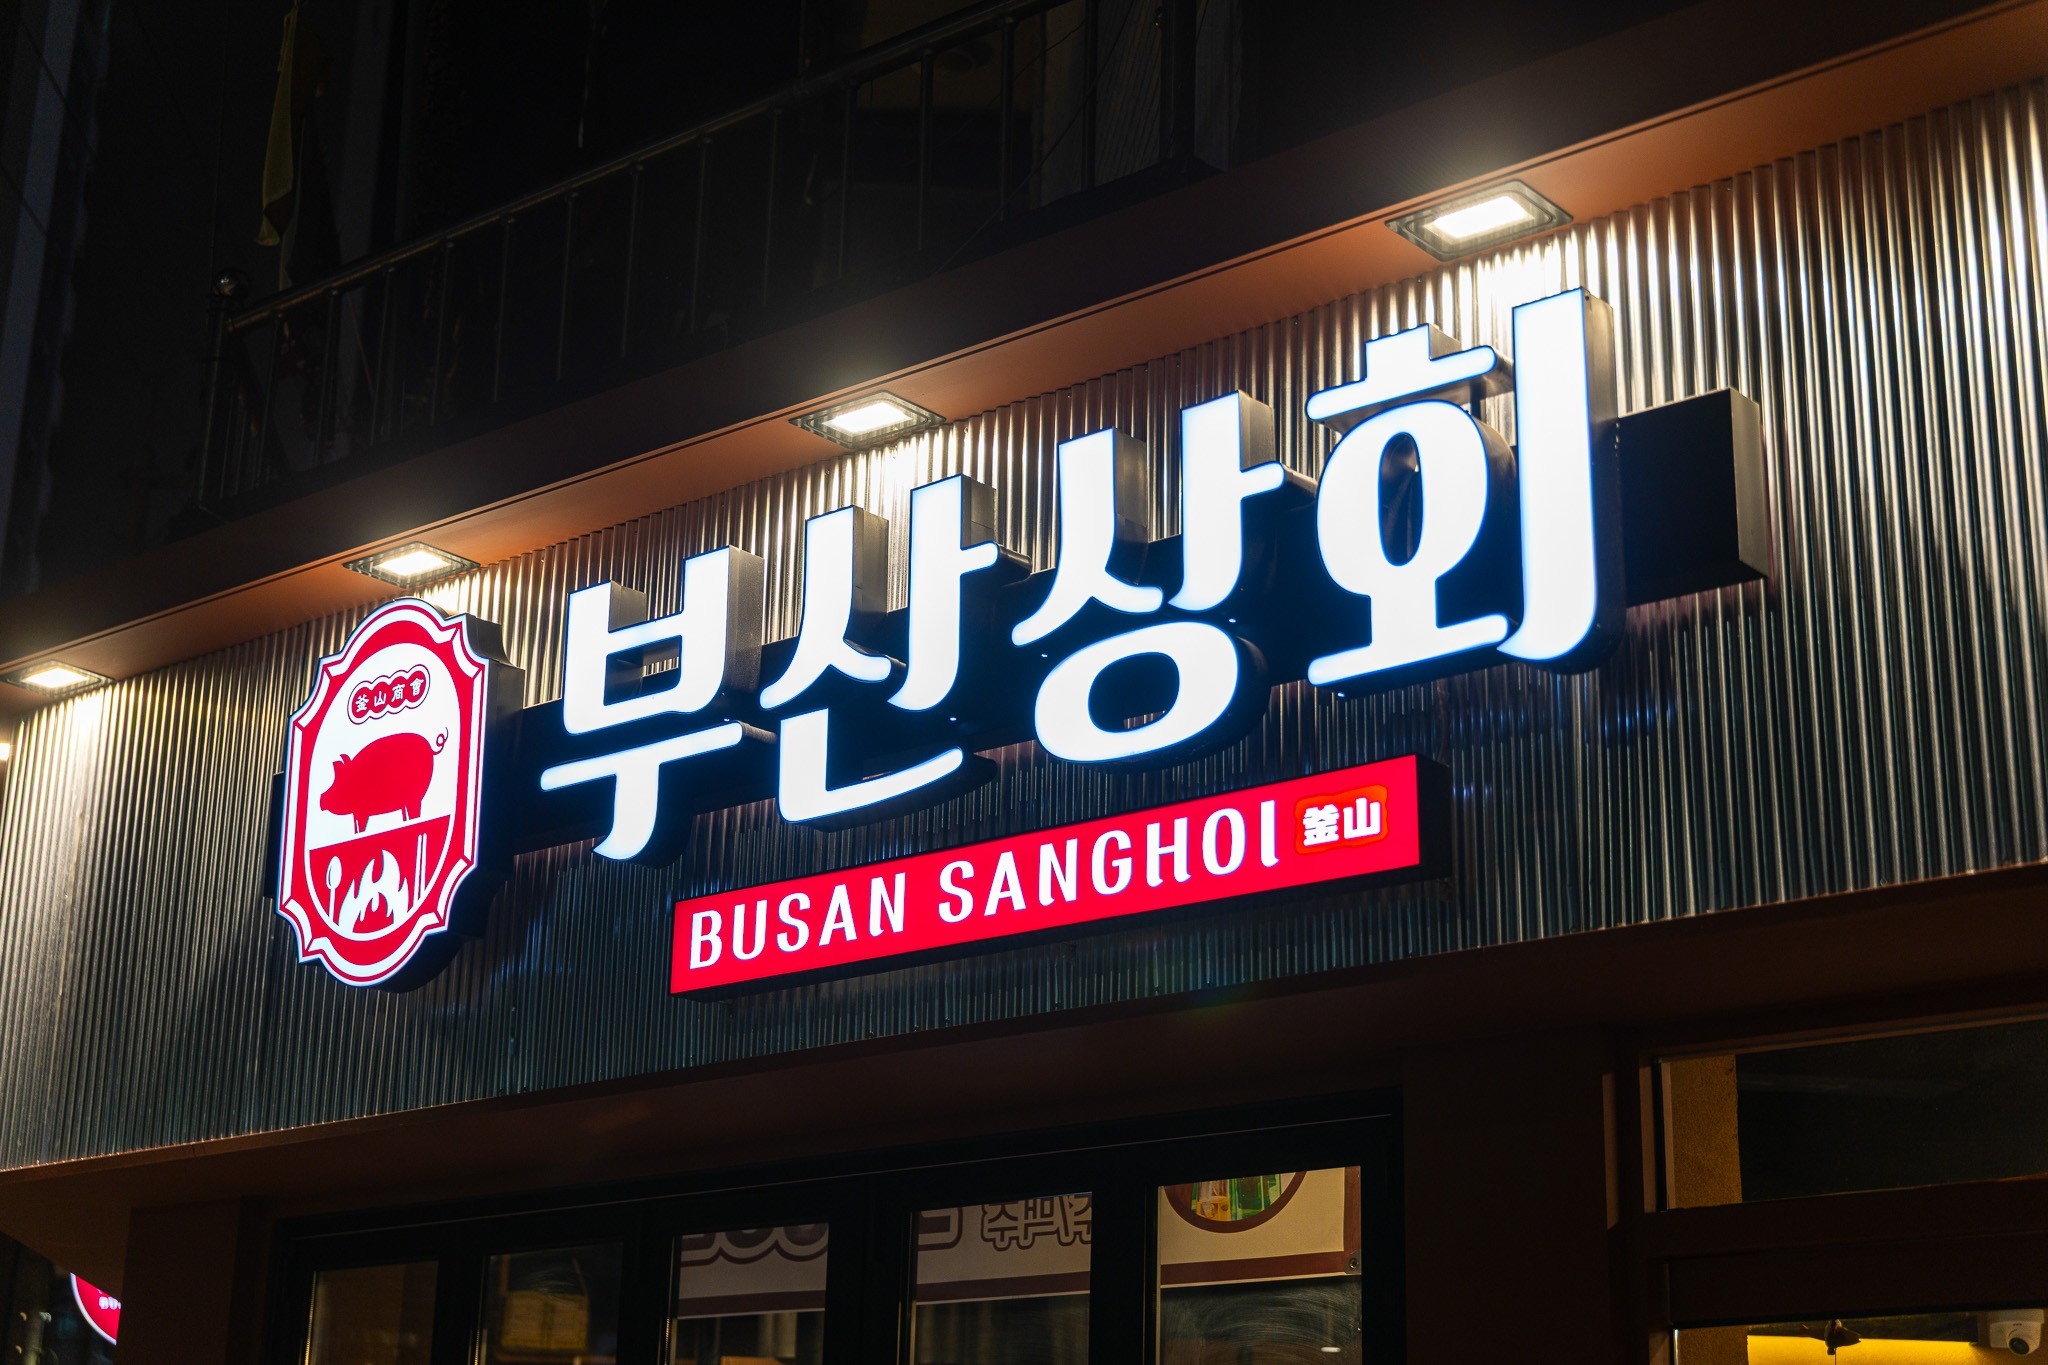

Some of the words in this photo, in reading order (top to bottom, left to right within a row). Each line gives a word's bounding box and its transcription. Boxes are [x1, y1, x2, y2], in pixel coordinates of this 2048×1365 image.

[540, 289, 1597, 861] 부산상회
[355, 677, 425, 713] 釜山商會
[1302, 797, 1381, 846] 釜山
[689, 872, 906, 970] BUSAN
[938, 799, 1279, 923] SANGHOI
